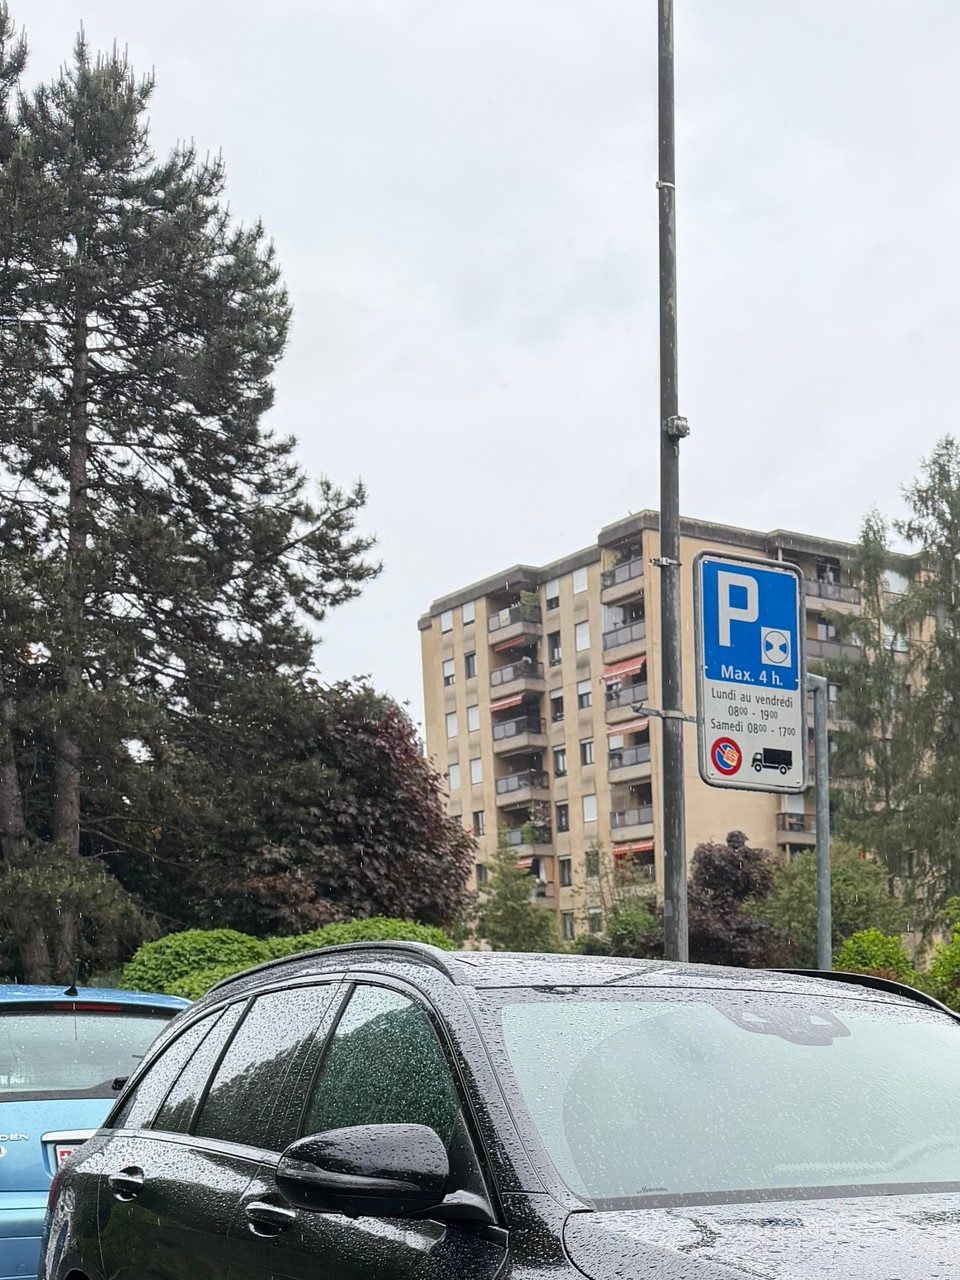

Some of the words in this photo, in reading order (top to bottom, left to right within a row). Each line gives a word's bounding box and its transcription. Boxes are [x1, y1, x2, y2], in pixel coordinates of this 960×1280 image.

[717, 570, 759, 647] P
[721, 664, 755, 682] Max.
[759, 670, 767, 683] 4
[771, 671, 783, 685] h.
[711, 687, 736, 701] Lundi
[740, 693, 751, 703] au
[755, 695, 793, 708] vendredi
[710, 718, 743, 732] Samedi
